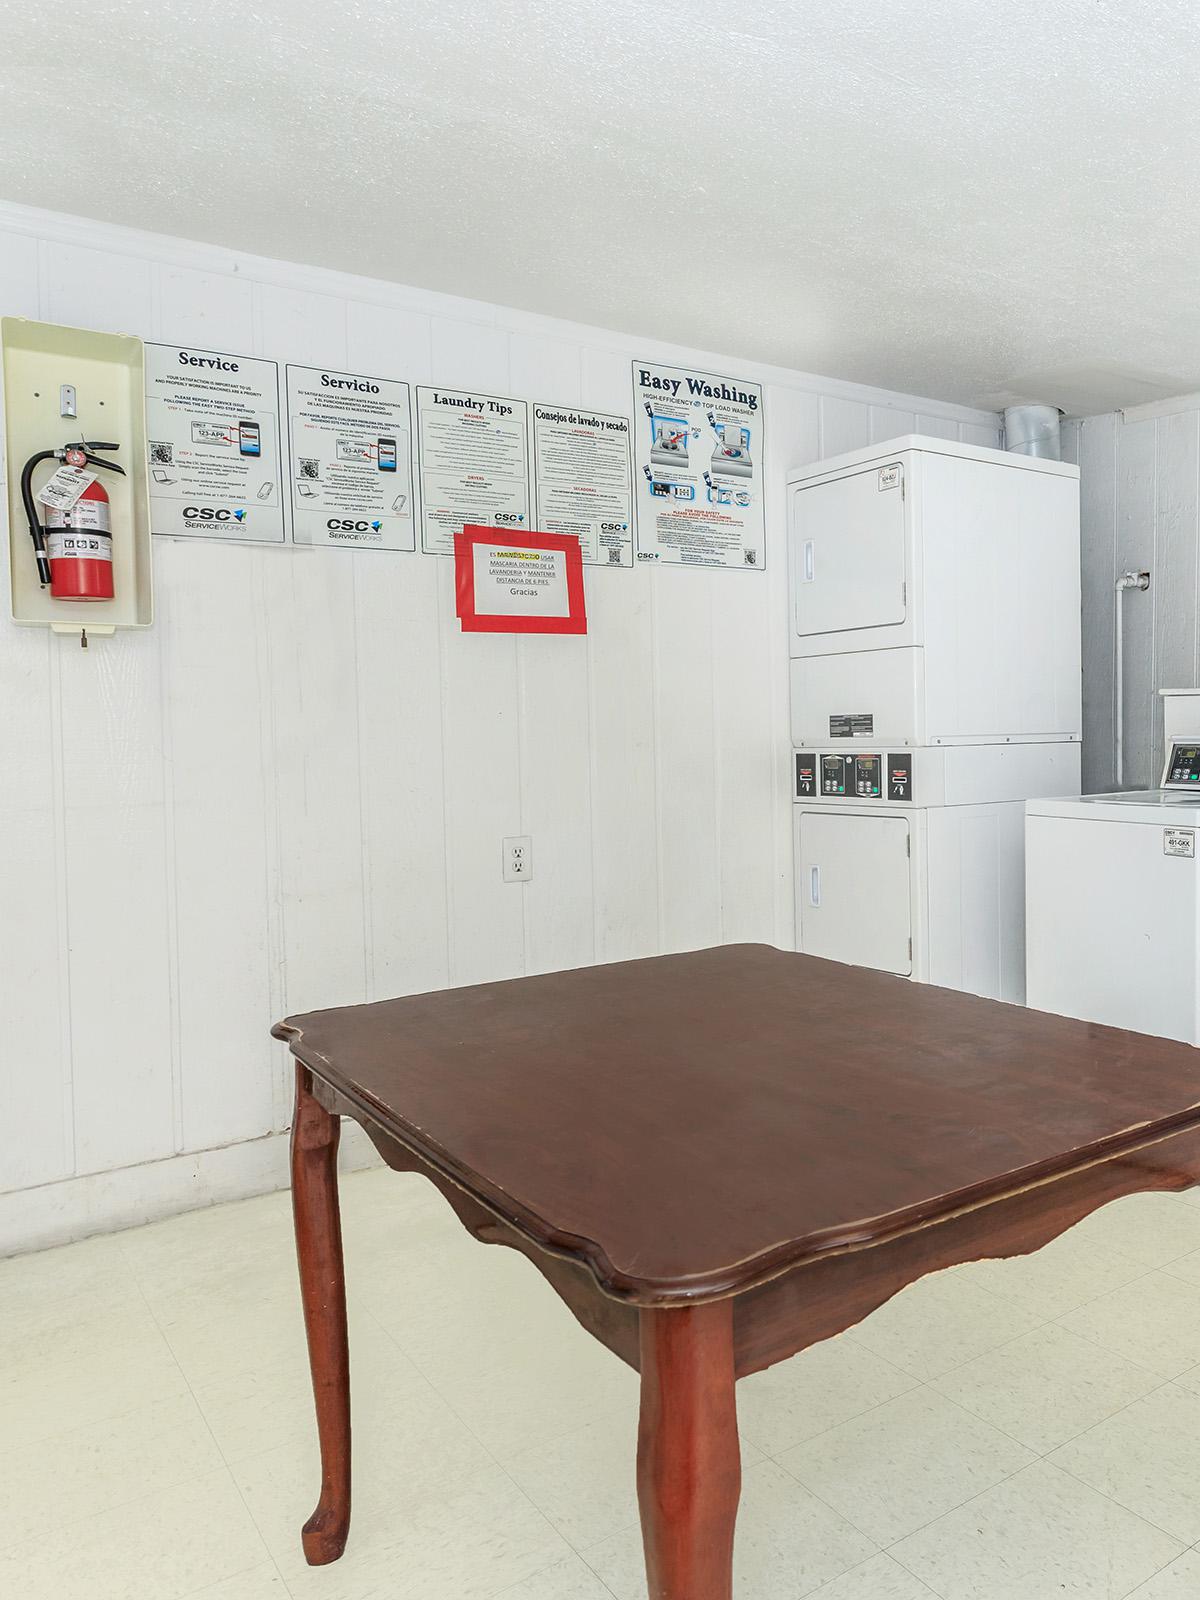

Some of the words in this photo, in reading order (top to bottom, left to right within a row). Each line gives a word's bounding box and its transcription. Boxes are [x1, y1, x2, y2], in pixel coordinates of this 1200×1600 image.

[178, 352, 239, 372] Service
[321, 374, 379, 394] Servicio
[639, 369, 681, 397] Easy
[685, 377, 758, 410] Washing
[433, 393, 485, 413] Laundry
[487, 401, 512, 416] Tips
[731, 407, 755, 416] WASHER
[536, 409, 567, 424] Consejos
[568, 414, 577, 424] de
[578, 415, 599, 427] lavado
[601, 421, 605, 430] y
[606, 422, 627, 432] secado
[182, 507, 231, 521] CSC
[494, 513, 517, 521] CSC
[327, 519, 369, 531] CSC
[601, 523, 621, 531] CSC
[510, 588, 538, 596] Gracias
